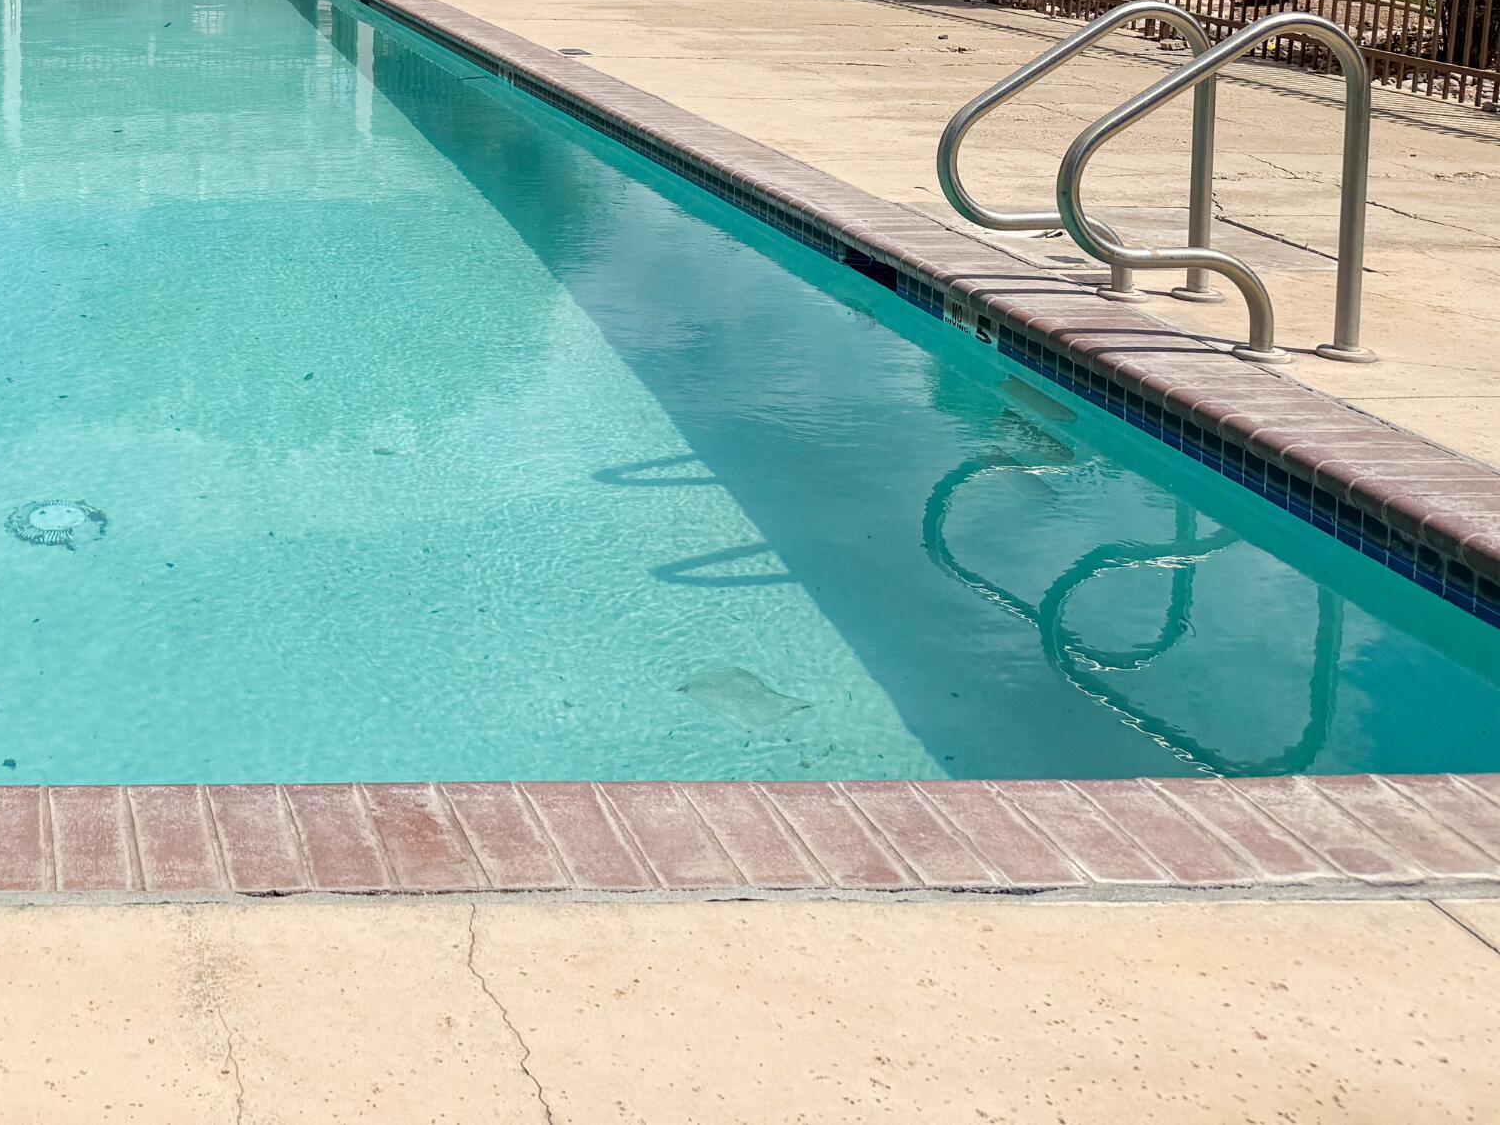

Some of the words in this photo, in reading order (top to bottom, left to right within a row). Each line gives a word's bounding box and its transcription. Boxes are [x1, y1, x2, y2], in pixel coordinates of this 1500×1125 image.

[952, 302, 963, 323] NO
[944, 317, 969, 334] DIVING
[975, 314, 992, 344] 5
